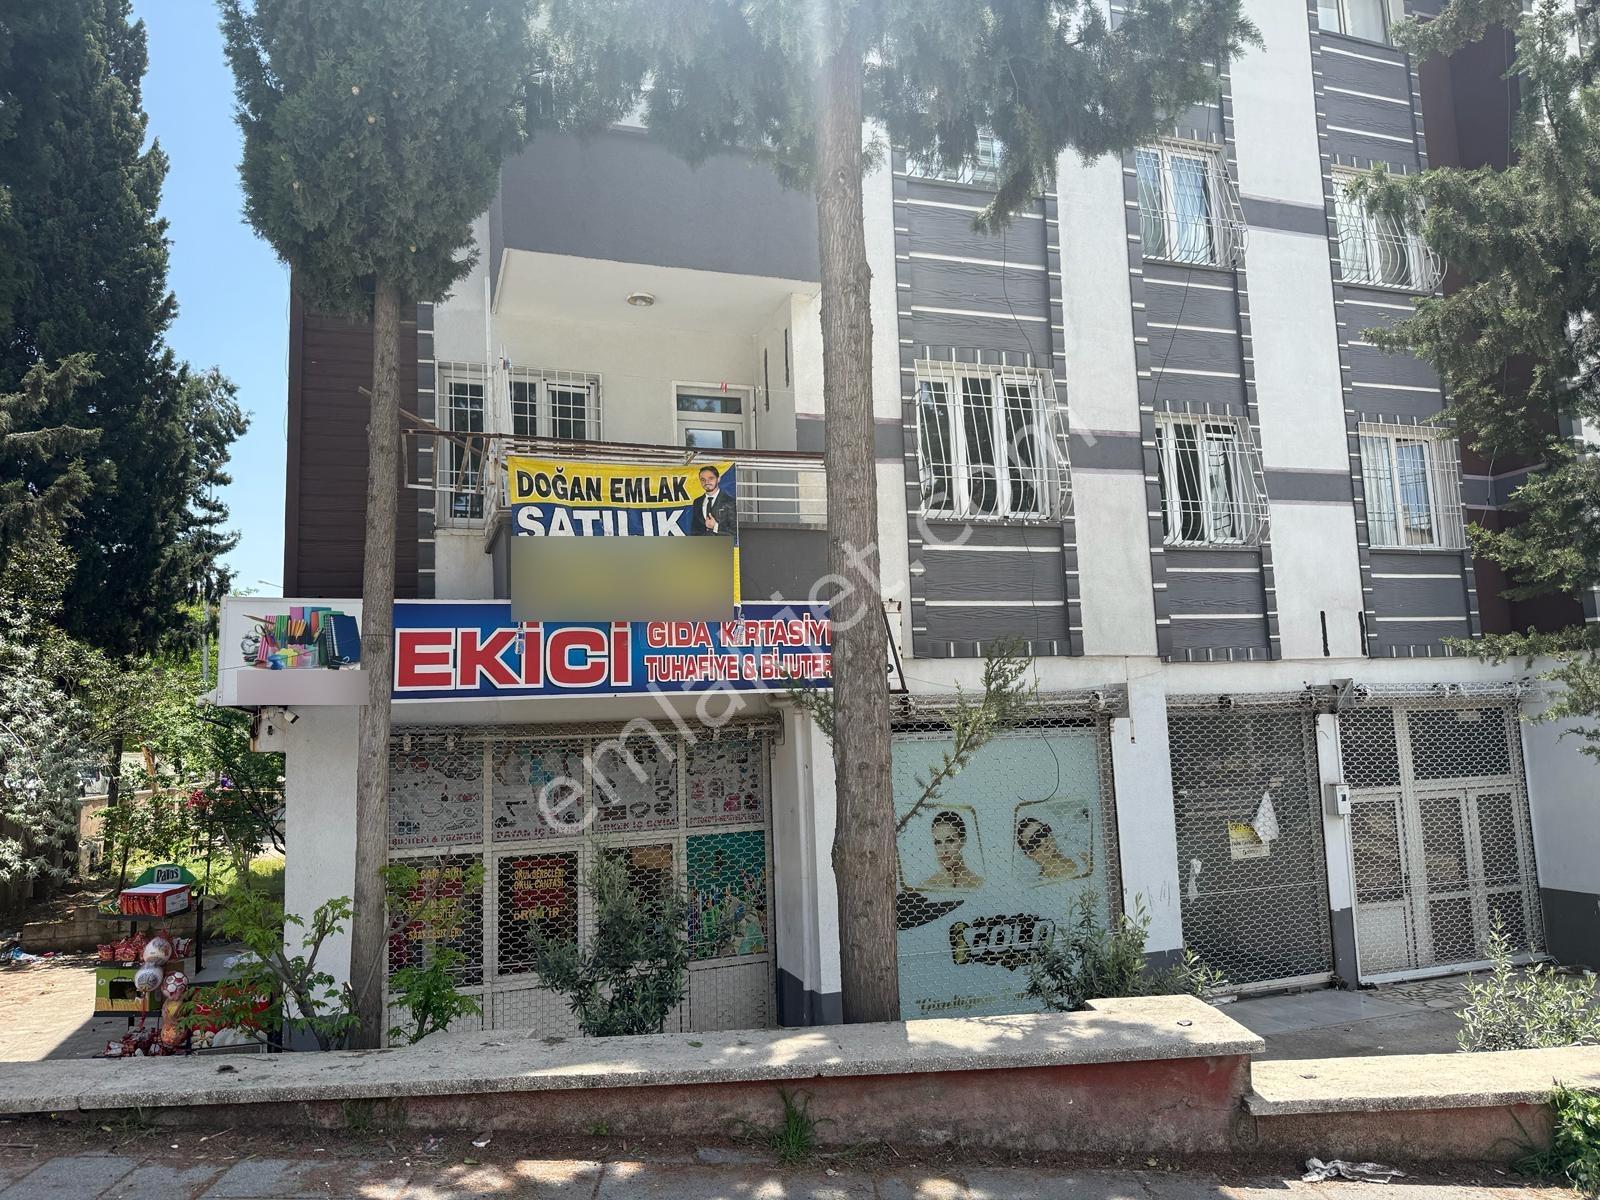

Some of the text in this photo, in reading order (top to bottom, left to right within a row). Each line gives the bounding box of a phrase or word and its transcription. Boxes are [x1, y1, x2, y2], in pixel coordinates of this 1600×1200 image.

[516, 466, 692, 503] DOĞAN EMLAK
[516, 505, 687, 537] SATILIK
[646, 621, 713, 648] GIDA
[394, 621, 633, 692] EKİCİ
[644, 647, 739, 682] TUHAFİYE
[743, 654, 758, 681] &
